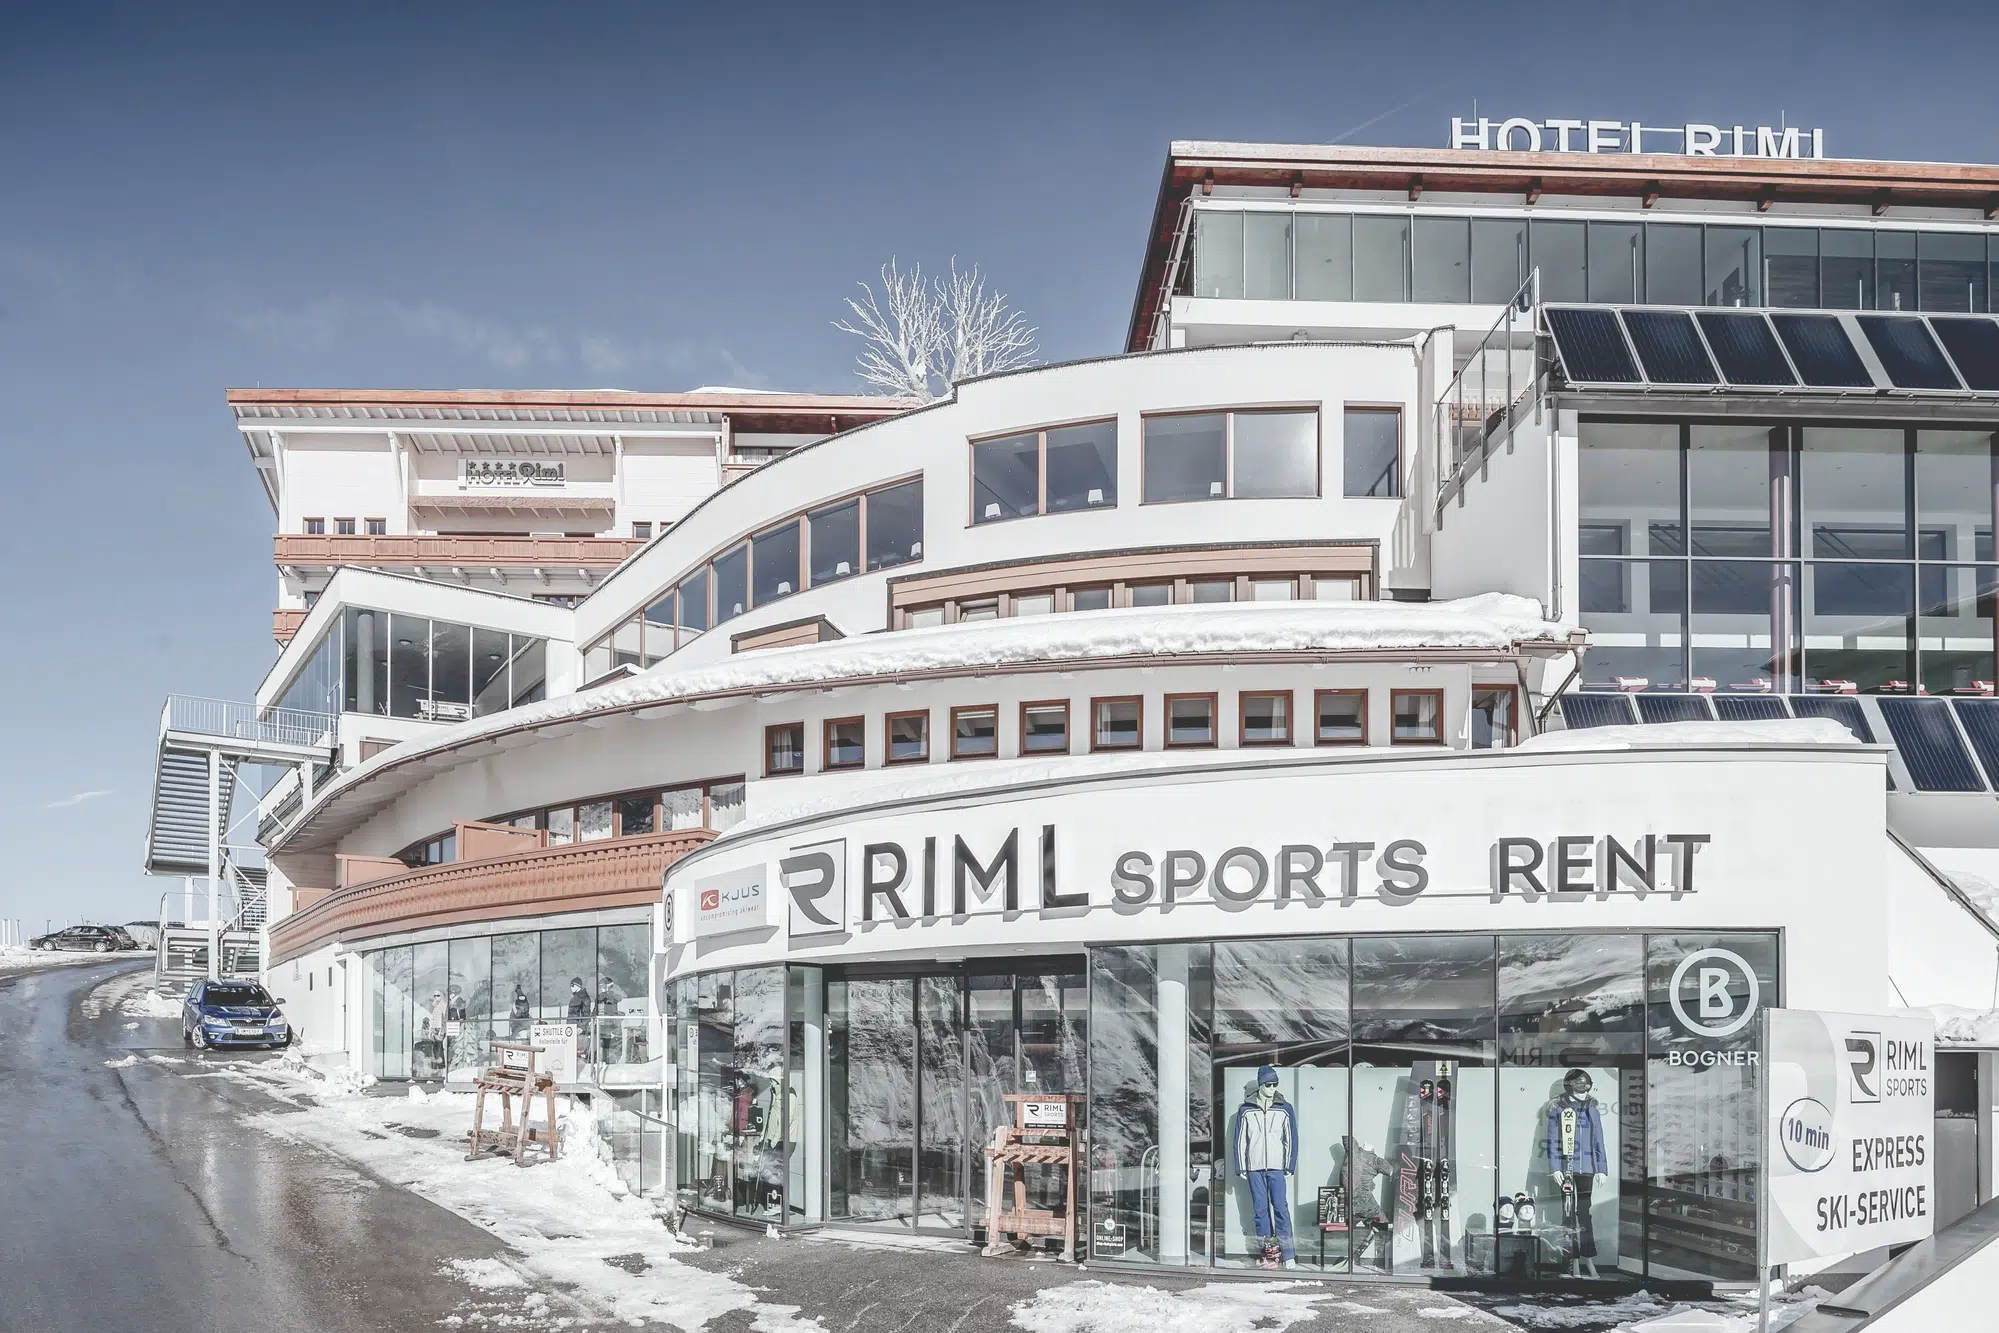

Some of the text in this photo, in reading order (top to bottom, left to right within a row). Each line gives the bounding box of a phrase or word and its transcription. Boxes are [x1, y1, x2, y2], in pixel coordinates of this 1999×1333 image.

[468, 462, 565, 487] HOTEL Riml
[864, 824, 1710, 921] RIML SPORTS RENT
[722, 884, 760, 902] KJUS
[543, 1028, 563, 1036] SHUTTLE
[1669, 1050, 1760, 1067] BOGNER
[1886, 1040, 1927, 1072] RIML
[1886, 1078, 1927, 1097] SPORTS
[1044, 1104, 1064, 1112] RIML
[1788, 1117, 1830, 1151] 10 min
[1852, 1134, 1925, 1173] EXPRESS
[1816, 1185, 1927, 1232] SKI-SERVICE
